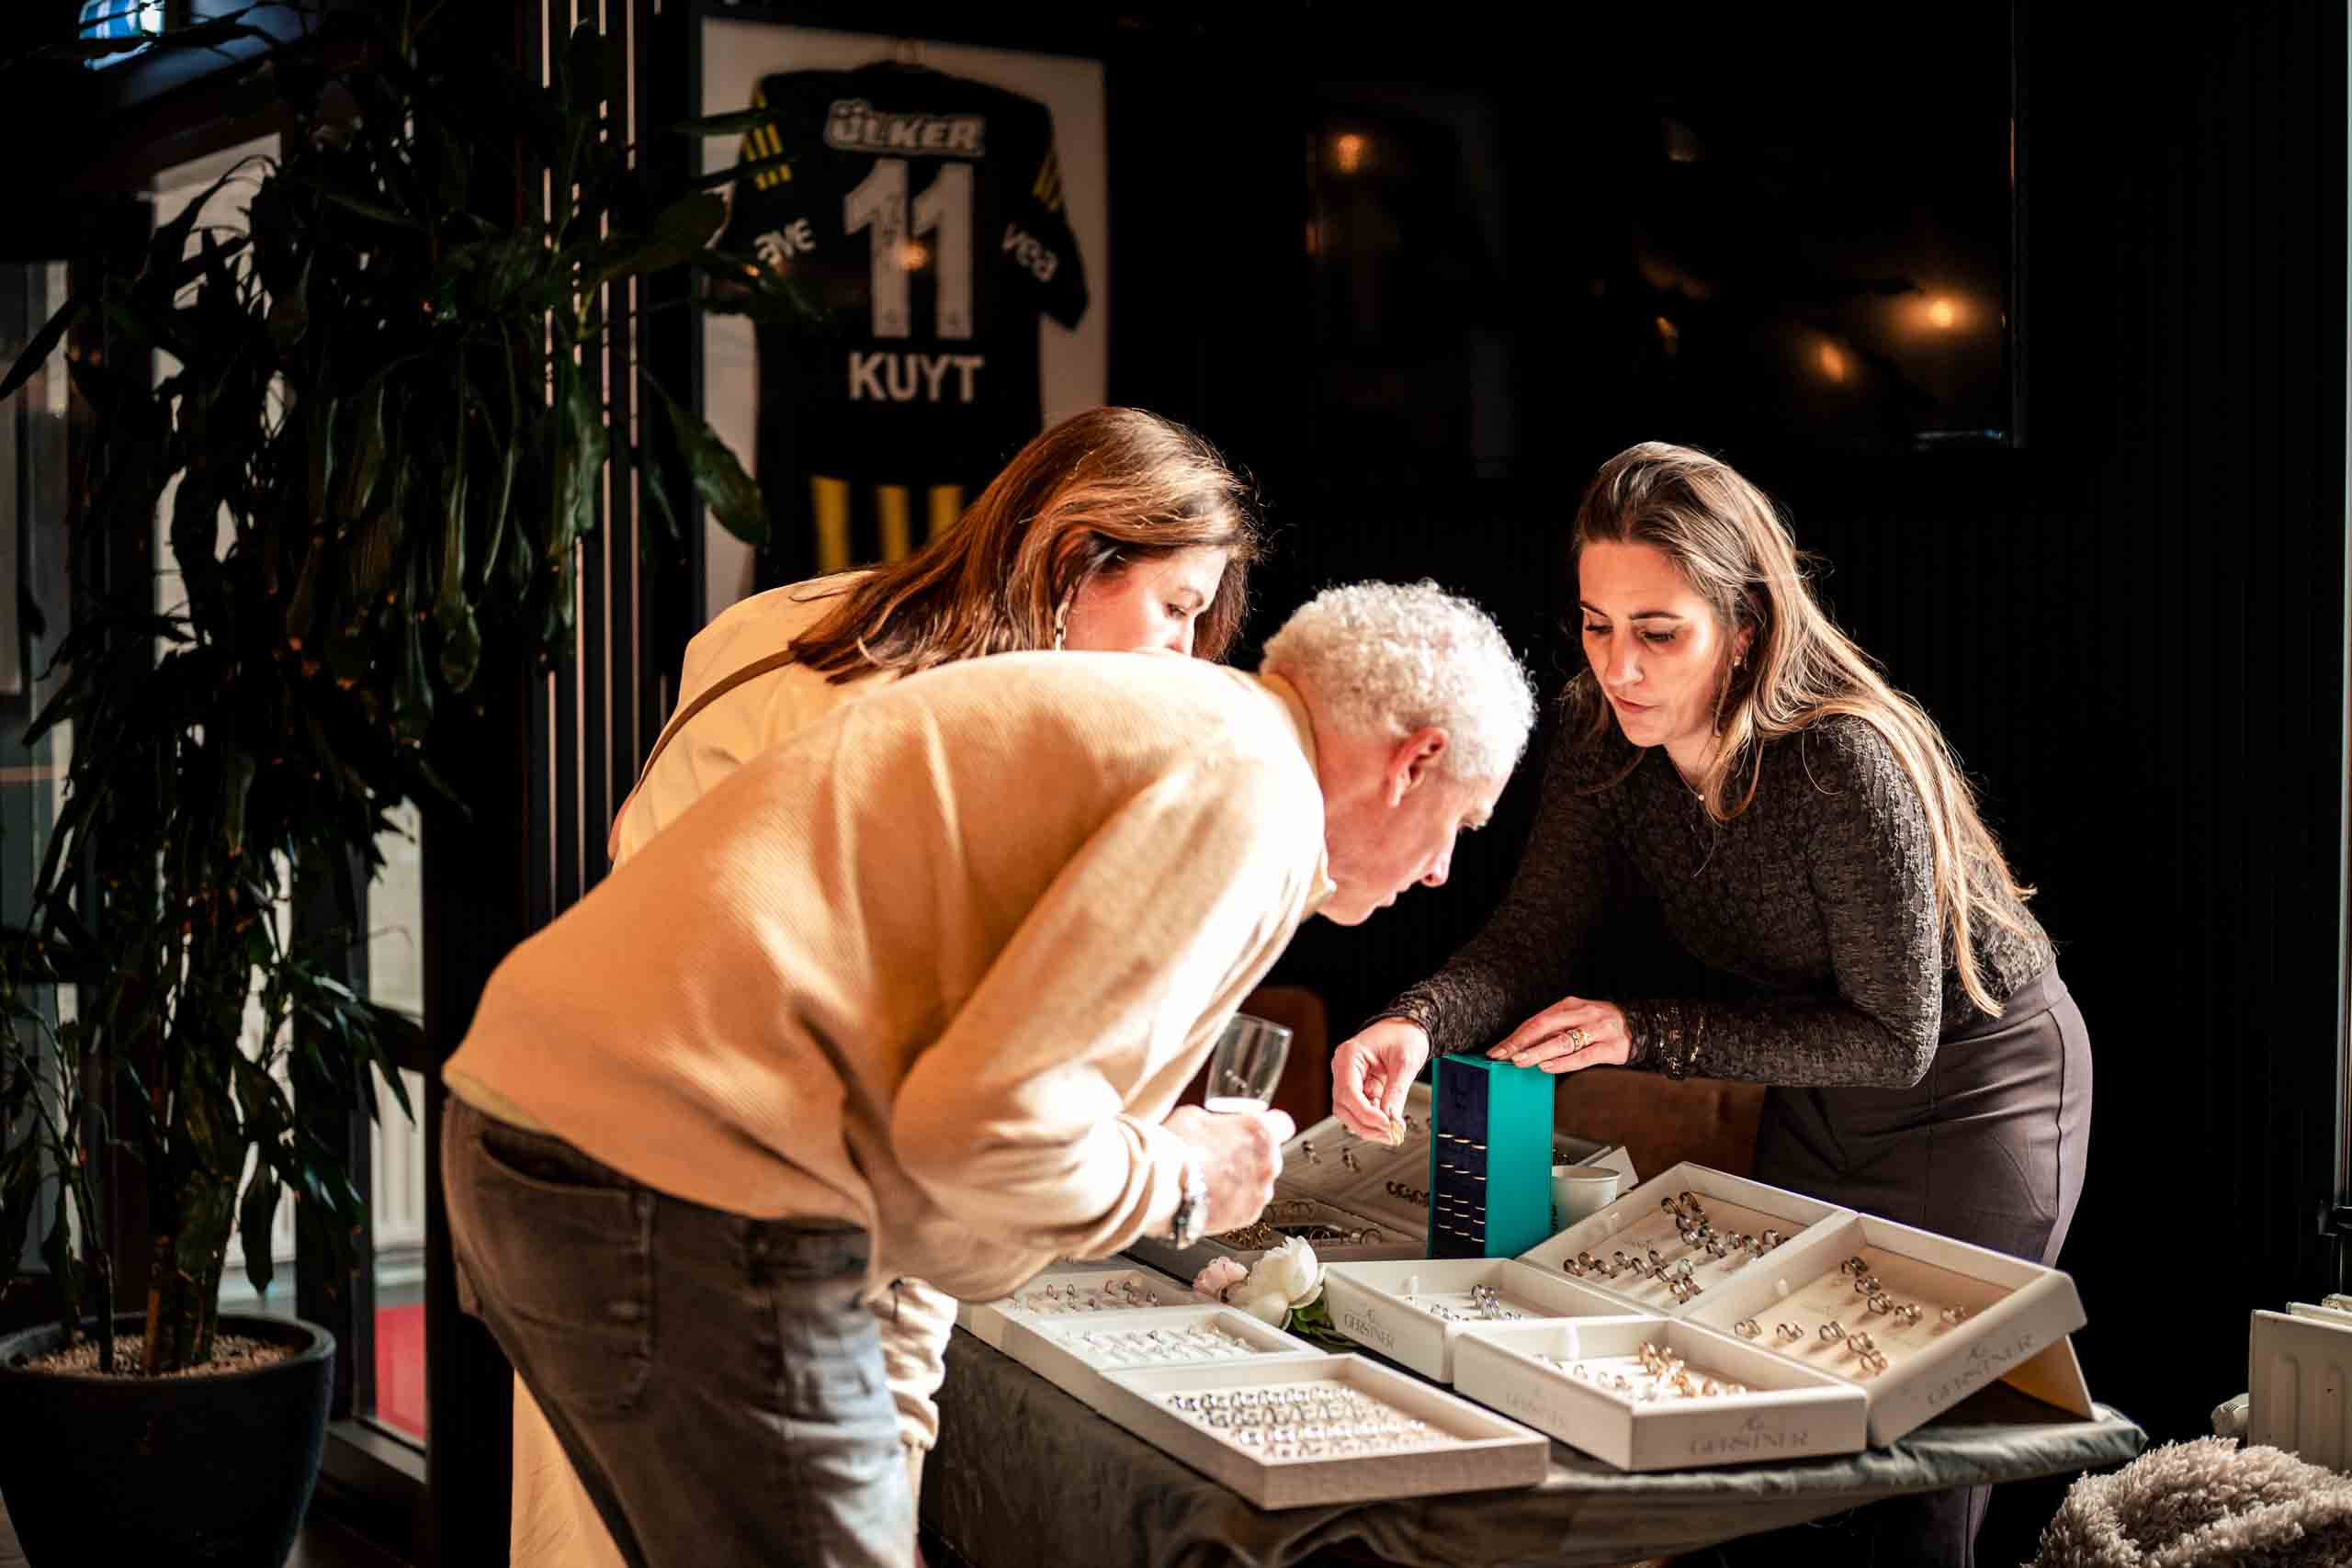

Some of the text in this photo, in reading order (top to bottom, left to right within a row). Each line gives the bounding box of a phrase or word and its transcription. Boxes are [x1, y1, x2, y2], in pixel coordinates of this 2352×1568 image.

[828, 101, 983, 153] ÜLKER
[843, 159, 974, 339] 11
[848, 351, 985, 403] KUYT
